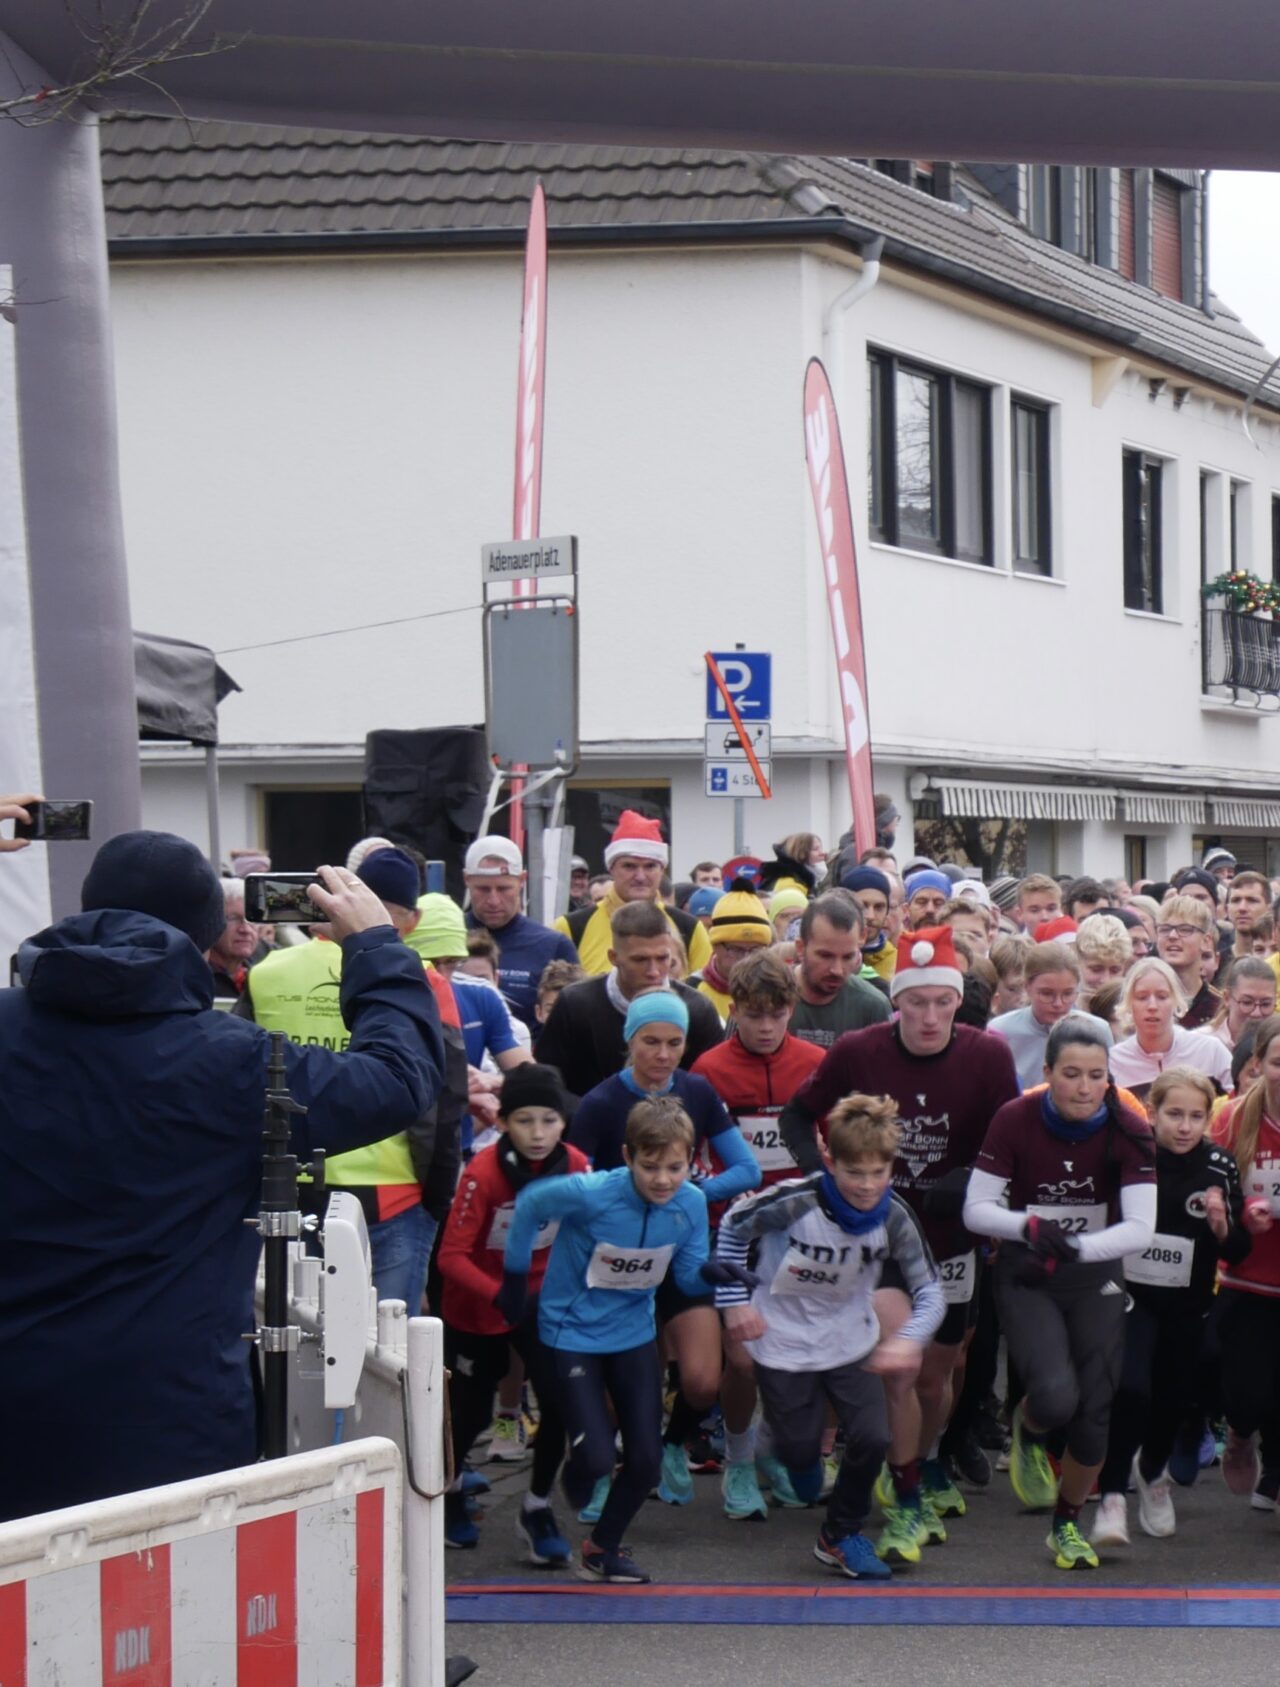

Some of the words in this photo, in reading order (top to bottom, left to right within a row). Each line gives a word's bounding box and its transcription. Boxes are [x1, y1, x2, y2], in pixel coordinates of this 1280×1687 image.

[489, 547, 560, 573] Adenauerplatz
[716, 660, 751, 712] P
[732, 775, 739, 785] 4
[915, 1134, 948, 1145] BONN
[1060, 1196, 1095, 1204] BONN
[1051, 1217, 1088, 1233] 22
[1142, 1249, 1183, 1264] 2089
[610, 1258, 653, 1273] 964
[939, 1261, 966, 1281] 32
